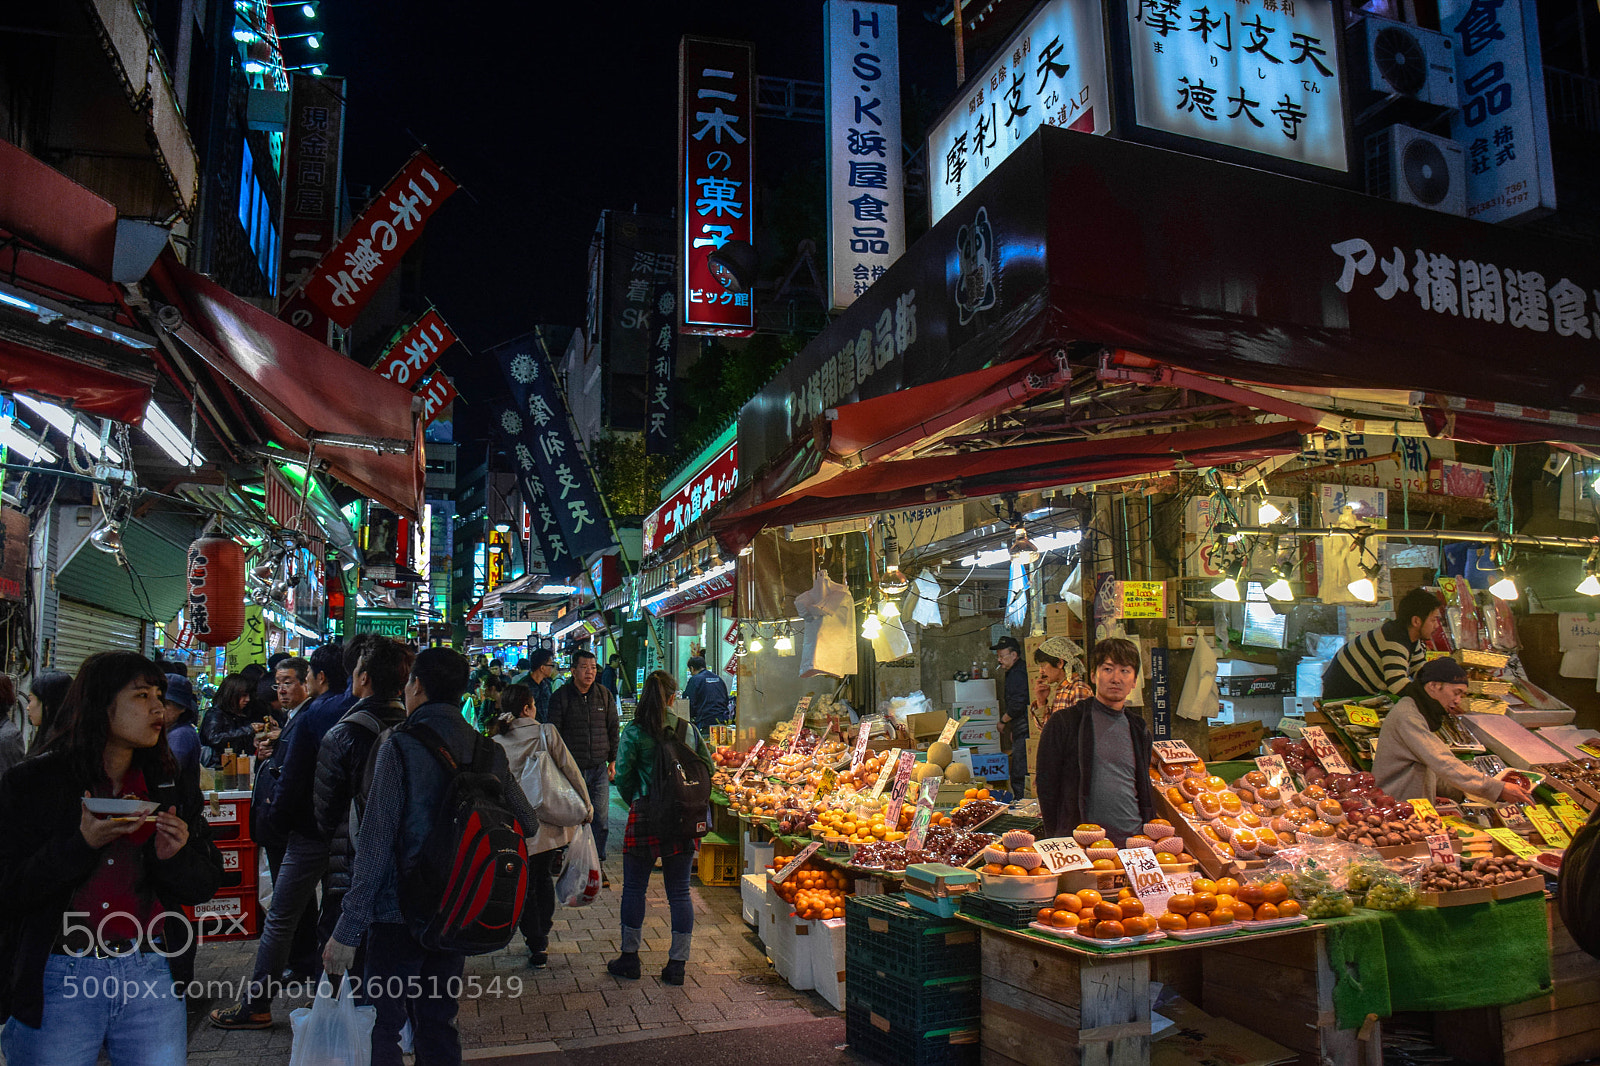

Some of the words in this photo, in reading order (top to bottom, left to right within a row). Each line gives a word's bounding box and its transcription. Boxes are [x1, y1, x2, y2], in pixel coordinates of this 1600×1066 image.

[1176, 76, 1308, 142] 徳大寺
[689, 288, 750, 308] ビック館
[1330, 237, 1600, 341] アメ横開運食
[650, 323, 673, 439] 摩利支天
[195, 903, 231, 914] SAPPORO
